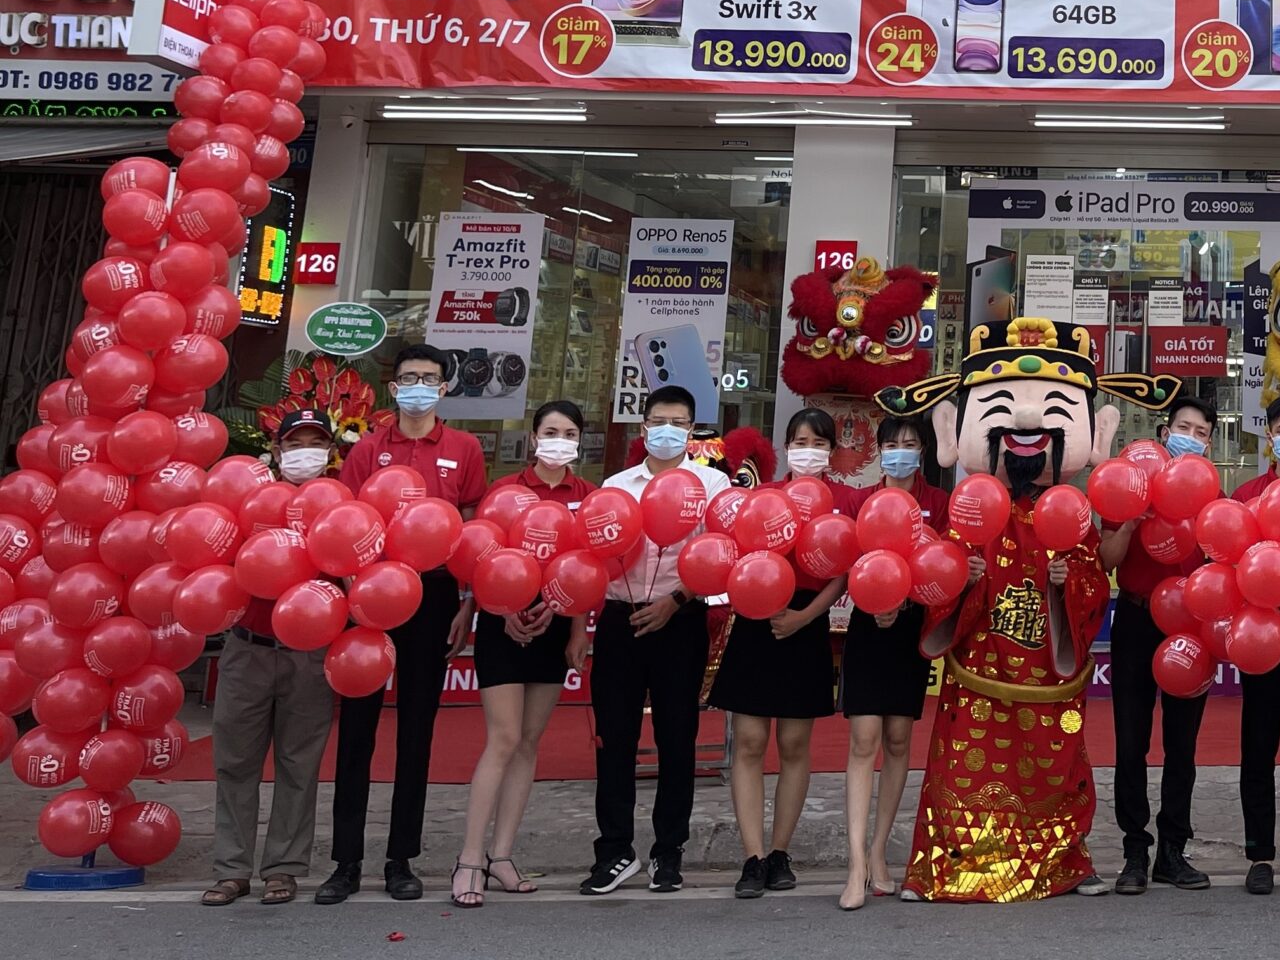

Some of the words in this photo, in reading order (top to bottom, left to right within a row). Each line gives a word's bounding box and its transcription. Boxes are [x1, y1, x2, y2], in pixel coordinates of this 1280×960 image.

[718, 0, 782, 19] Swift
[787, 1, 817, 20] 3x
[1053, 5, 1116, 25] 64GB
[369, 13, 442, 44] THỨ
[445, 16, 470, 46] 6,
[479, 18, 530, 47] 2/7
[552, 34, 607, 65] 17%
[699, 40, 846, 68] 18.990.000
[876, 43, 937, 72] 24%
[1012, 47, 1156, 74] 13.690.000
[1191, 49, 1250, 78] 20%
[39, 71, 98, 90] 0986
[107, 73, 152, 91] 982
[1078, 192, 1129, 213] iPad
[1138, 194, 1175, 213] Pro
[636, 228, 677, 241] OPPO
[683, 230, 727, 243] Reno5
[453, 238, 526, 253] Amazfit
[297, 254, 335, 272] 126
[446, 254, 494, 268] T-rex
[500, 255, 530, 269] Pro
[461, 272, 511, 281] 3.790.000
[632, 275, 692, 288] 400.000
[700, 276, 723, 288] 0%
[444, 300, 476, 308] Amazfit
[650, 307, 700, 316] CellphoneS
[453, 311, 480, 321] 750k
[1164, 337, 1187, 350] GIÁ
[1190, 335, 1215, 350] TỐT
[1156, 356, 1187, 364] NHANH
[1189, 353, 1223, 364] CHÓNG
